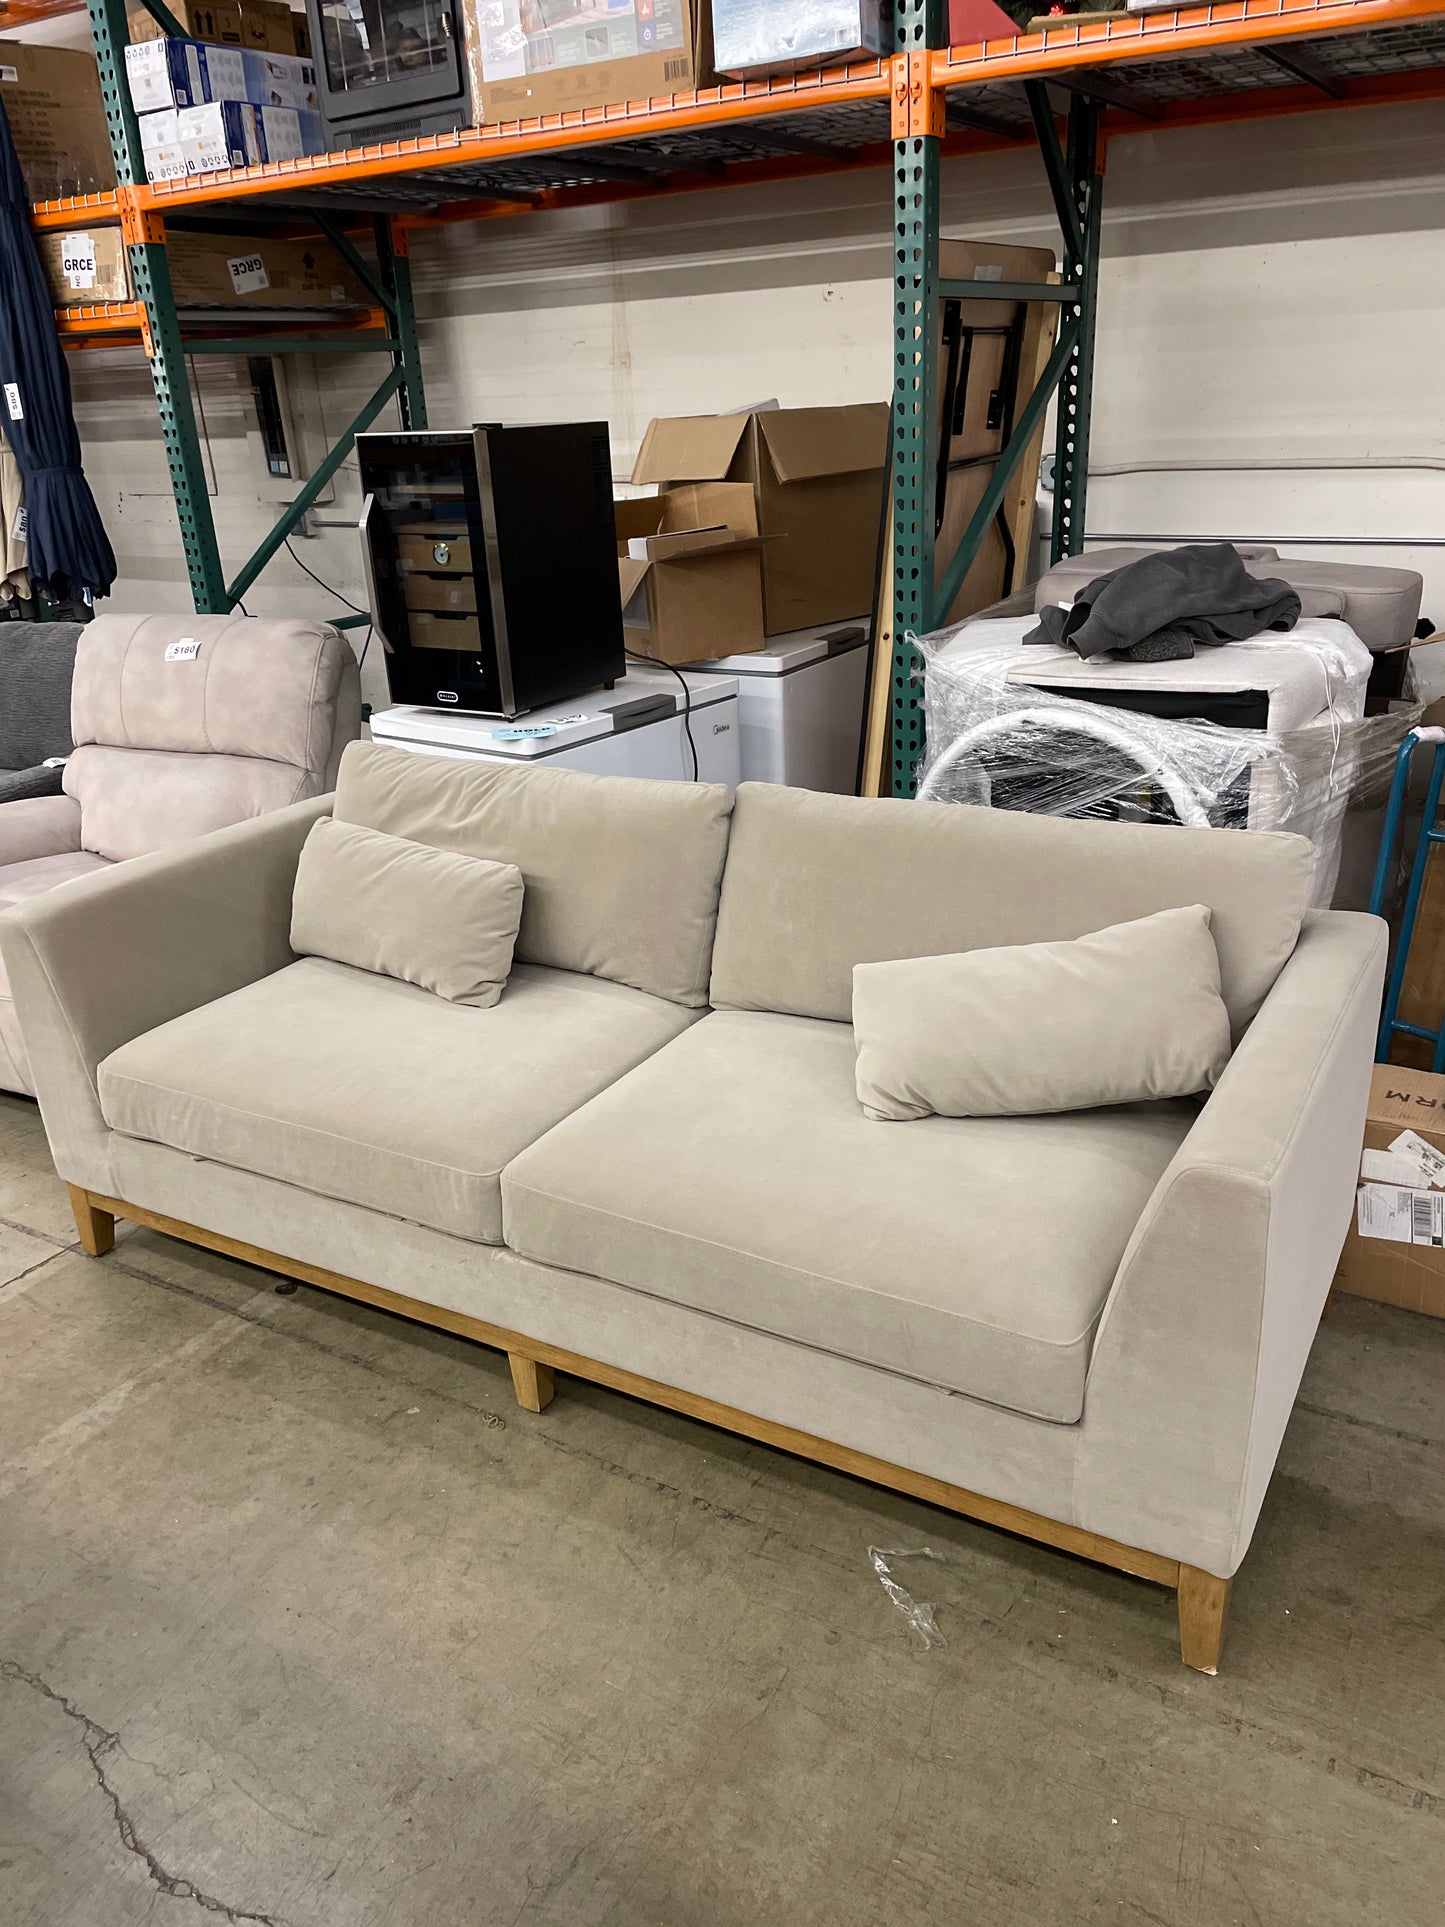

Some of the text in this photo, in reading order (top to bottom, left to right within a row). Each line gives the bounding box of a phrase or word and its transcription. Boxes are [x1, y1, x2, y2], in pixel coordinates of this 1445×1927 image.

[64, 258, 93, 271] GRCE
[231, 258, 262, 276] GRCE
[174, 645, 195, 655] $180
[1384, 1089, 1445, 1109] RM
